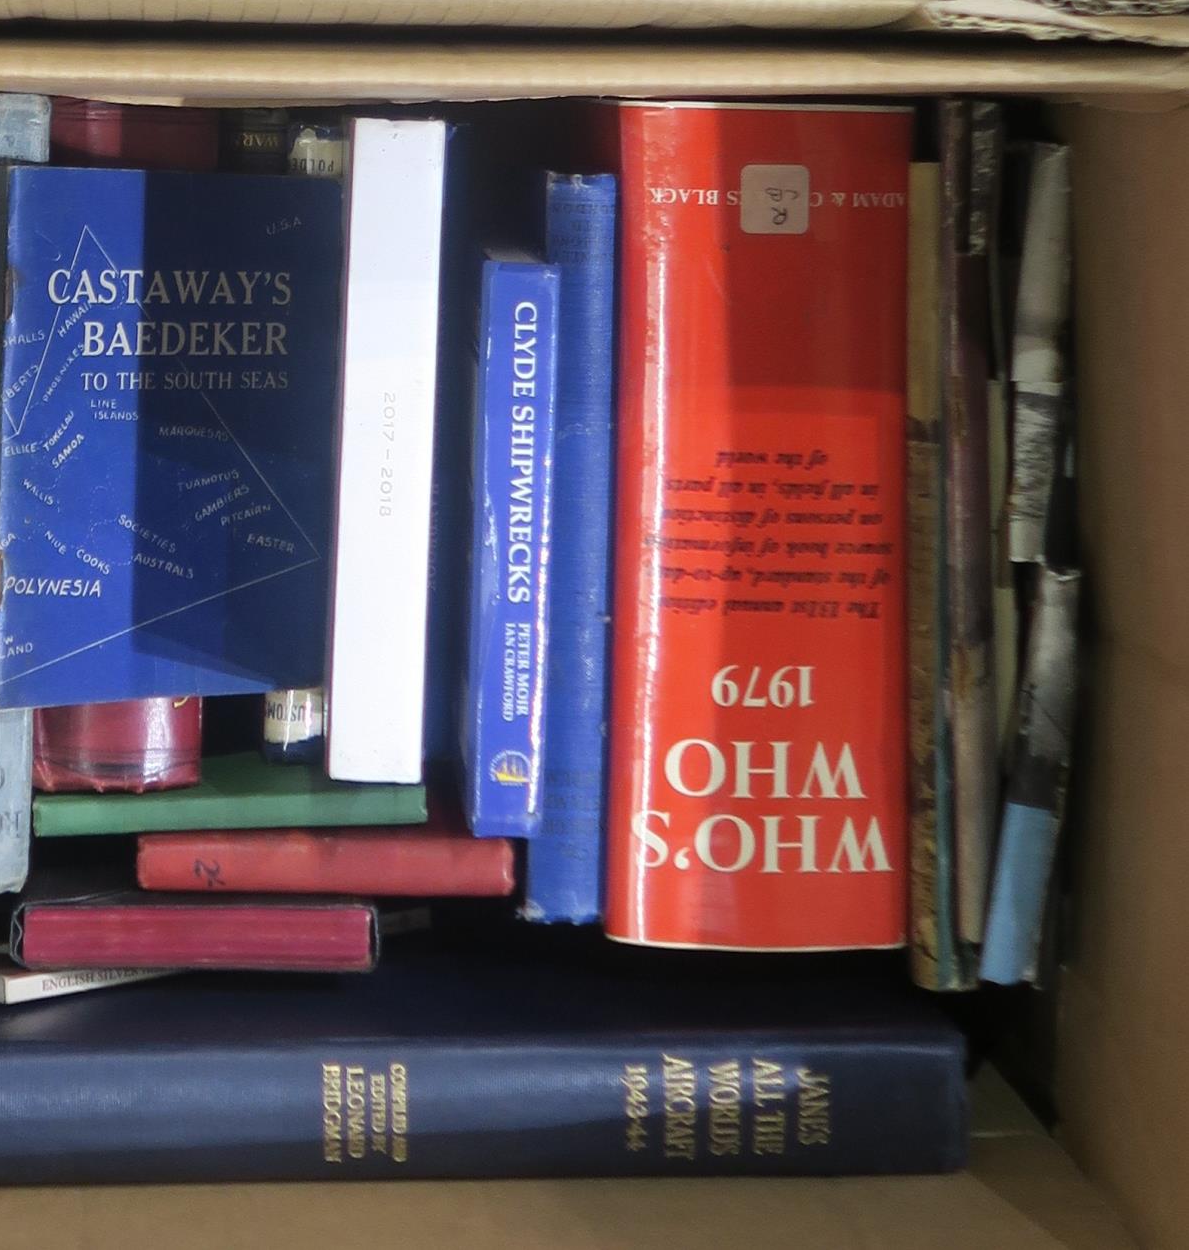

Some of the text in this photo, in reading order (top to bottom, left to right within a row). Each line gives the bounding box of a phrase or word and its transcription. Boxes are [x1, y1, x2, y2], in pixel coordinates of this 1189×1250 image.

[650, 187, 719, 207] BLACK
[48, 269, 292, 306] CASTAWAY'S
[82, 321, 289, 357] BAEDEKER
[82, 371, 289, 391] TO THE SOUTH SEAS
[91, 399, 118, 409] LINE
[93, 411, 140, 421] ISLANDS
[4, 441, 38, 457] ELLICE
[42, 410, 75, 452] TOKELAU
[51, 433, 85, 469] SAMOA
[378, 392, 397, 518] 2017 2018
[508, 301, 538, 604] CLYDE SHIPWRECKS
[22, 478, 55, 506] WALLIS
[177, 469, 240, 492] TUAMOTUS
[195, 484, 250, 521] GAMBIERS
[220, 502, 272, 526] PITCAIRN
[43, 529, 66, 555] NIUE
[117, 514, 177, 553] SOCIETIES
[246, 533, 295, 554] EASTER
[76, 548, 111, 575] COOKS
[3, 577, 102, 598] POLYNESIA
[502, 623, 516, 721] IAN CRAWFORD
[515, 623, 532, 716] PETER MOIR
[710, 664, 816, 708] 1979
[663, 738, 869, 800] WHO
[630, 809, 895, 874] WHO'S
[42, 973, 95, 992] ENGLISH
[752, 1057, 784, 1108] ALL
[662, 1053, 697, 1161] AIRCRAFT
